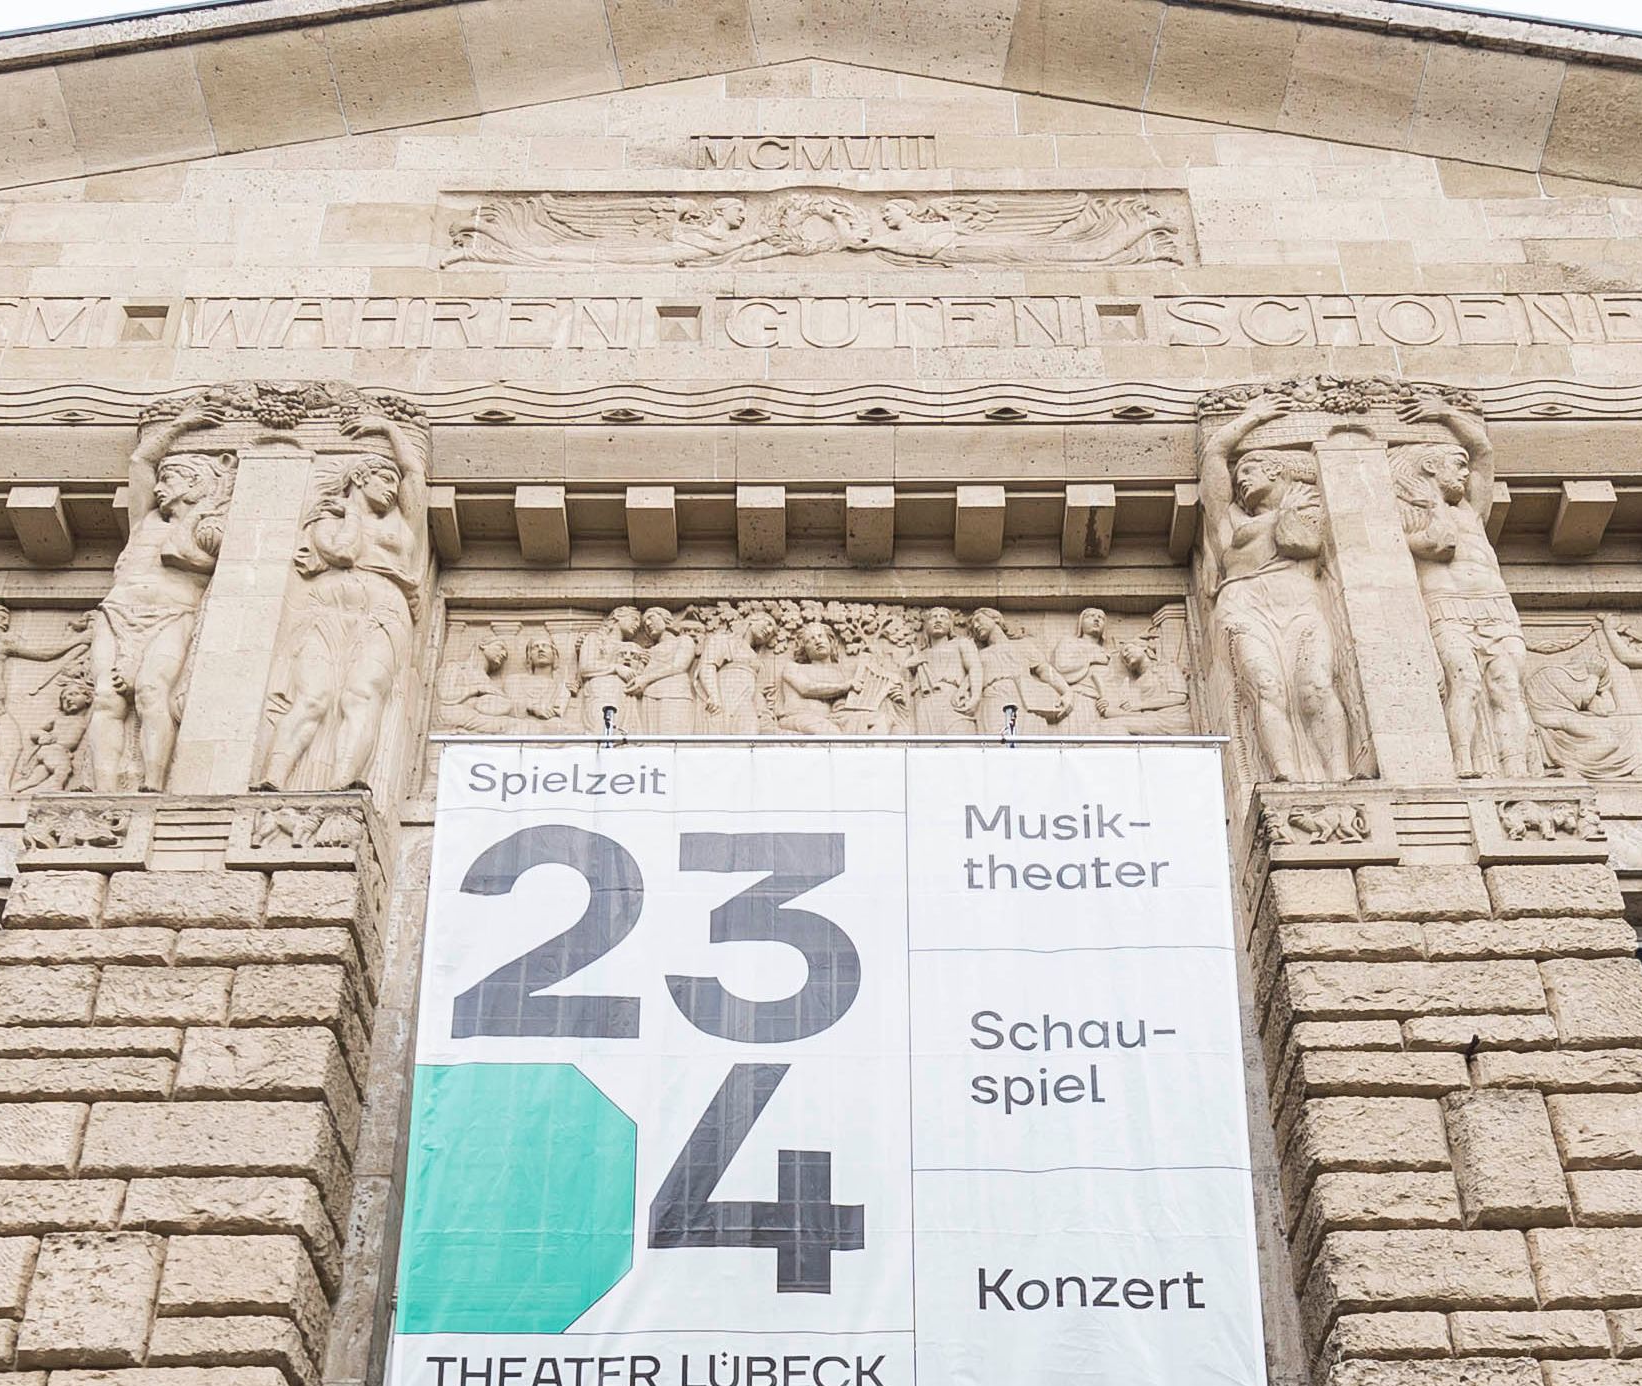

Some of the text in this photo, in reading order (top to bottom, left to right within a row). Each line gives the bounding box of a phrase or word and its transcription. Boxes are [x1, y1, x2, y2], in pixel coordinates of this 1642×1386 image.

[692, 136, 936, 170] MCMVIII
[185, 296, 644, 349] WAHREN
[719, 296, 1087, 349] GUTEN
[468, 763, 667, 803] Spielzeit
[964, 804, 1152, 841] Musik-
[963, 854, 1170, 891] theater
[451, 824, 862, 1044] 23
[969, 1010, 1177, 1052] Schau-
[970, 1064, 1106, 1115] spiel
[647, 1062, 865, 1295] 4
[977, 1267, 1207, 1312] Konzert
